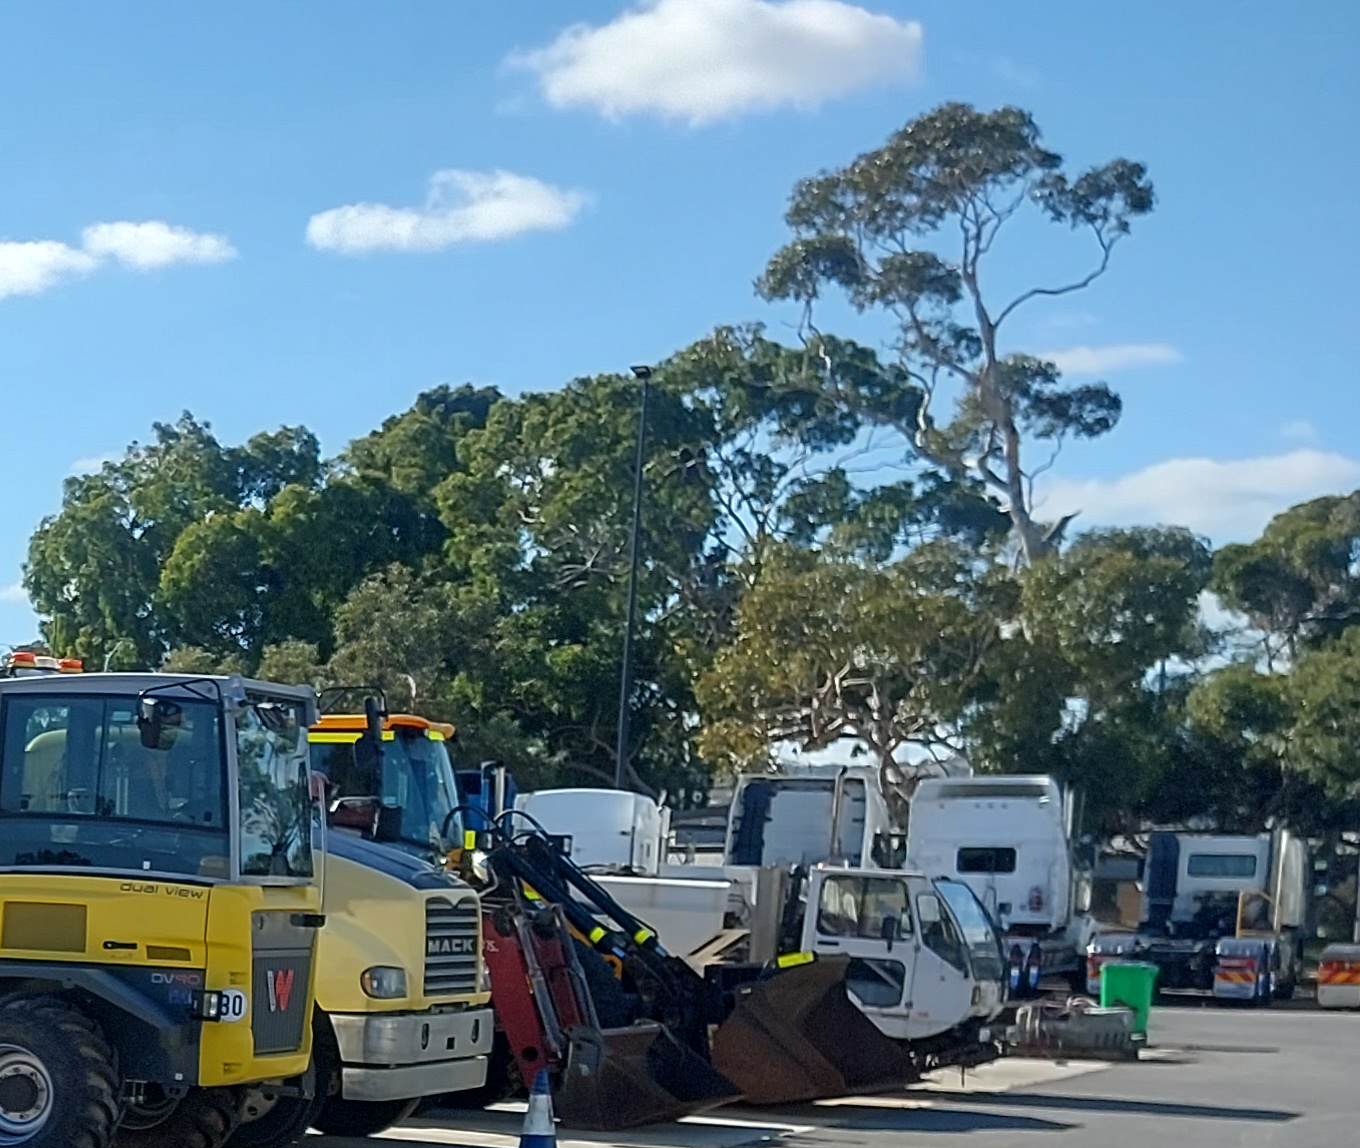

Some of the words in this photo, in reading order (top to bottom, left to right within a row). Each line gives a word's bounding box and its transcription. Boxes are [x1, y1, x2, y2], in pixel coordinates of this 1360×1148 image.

[120, 883, 158, 893] dual
[166, 887, 203, 899] view
[428, 939, 473, 953] MACK
[151, 973, 200, 985] DV90
